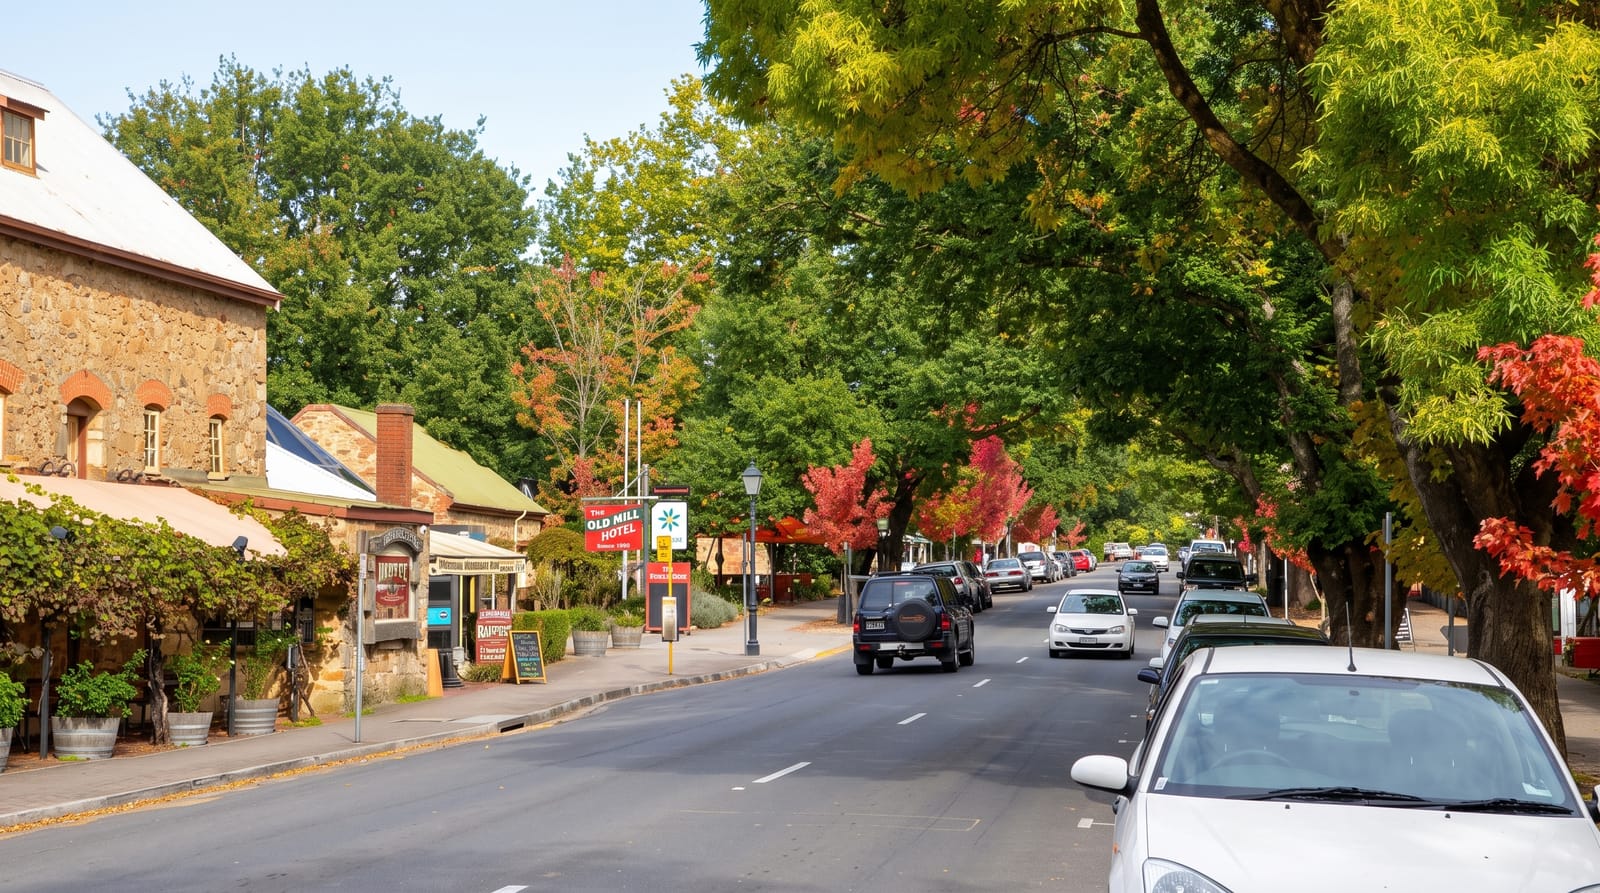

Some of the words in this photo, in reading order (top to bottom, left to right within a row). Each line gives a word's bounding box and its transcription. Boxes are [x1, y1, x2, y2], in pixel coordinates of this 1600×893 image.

[587, 518, 610, 530] OLD
[613, 509, 640, 525] MILL
[601, 523, 636, 541] HOTEL
